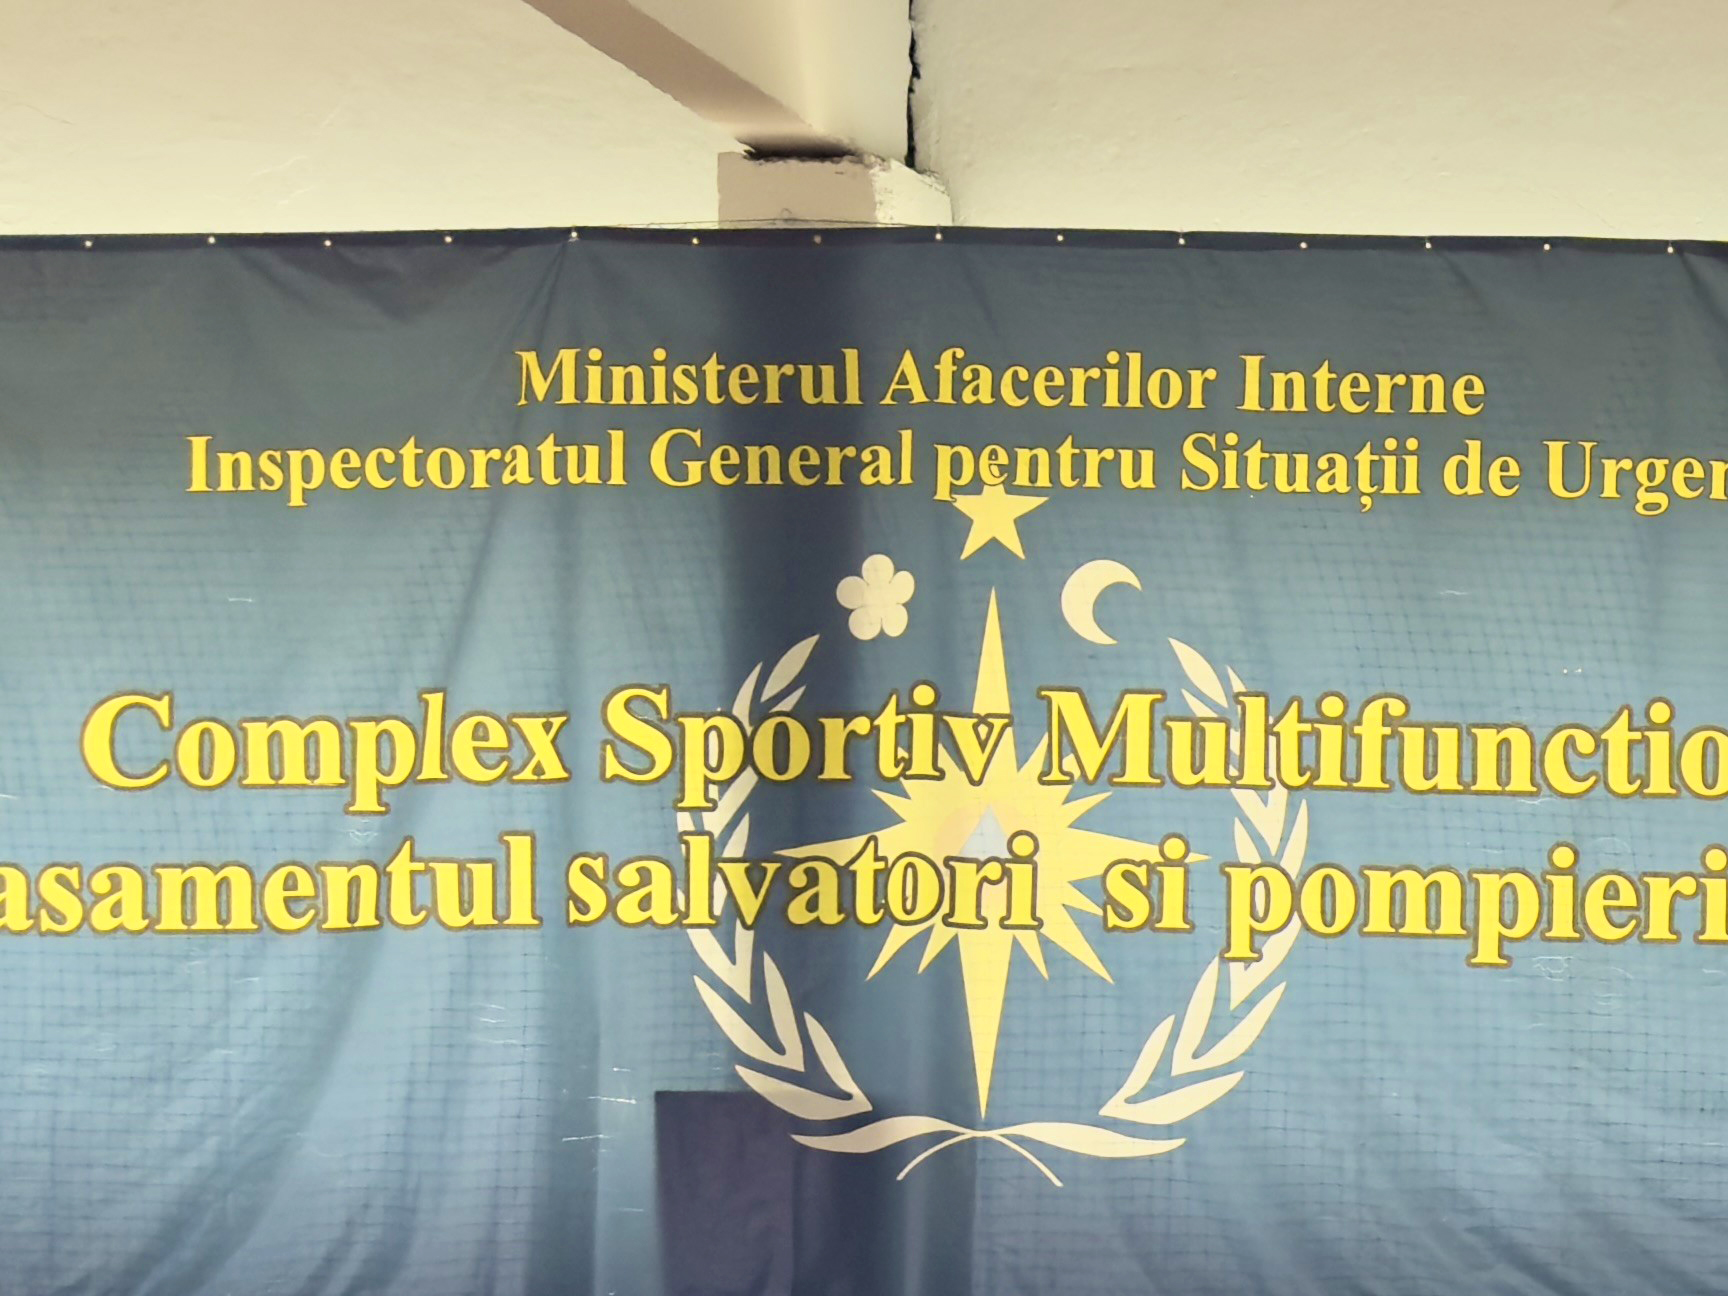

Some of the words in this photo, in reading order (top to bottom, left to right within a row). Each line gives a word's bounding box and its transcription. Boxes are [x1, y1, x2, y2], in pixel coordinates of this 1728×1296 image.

[515, 347, 863, 408] Ministerul
[881, 347, 1217, 410] Afacerilor
[1236, 353, 1487, 416] Interne
[185, 429, 628, 507] Inspectoratul
[649, 427, 915, 489] General
[933, 436, 1156, 502] pentru
[1179, 431, 1421, 512] Situații
[1443, 439, 1520, 497] de
[80, 688, 572, 815] Complex
[599, 682, 1009, 815] Sportiv
[566, 828, 1043, 931] salvatori
[1102, 834, 1194, 936] si
